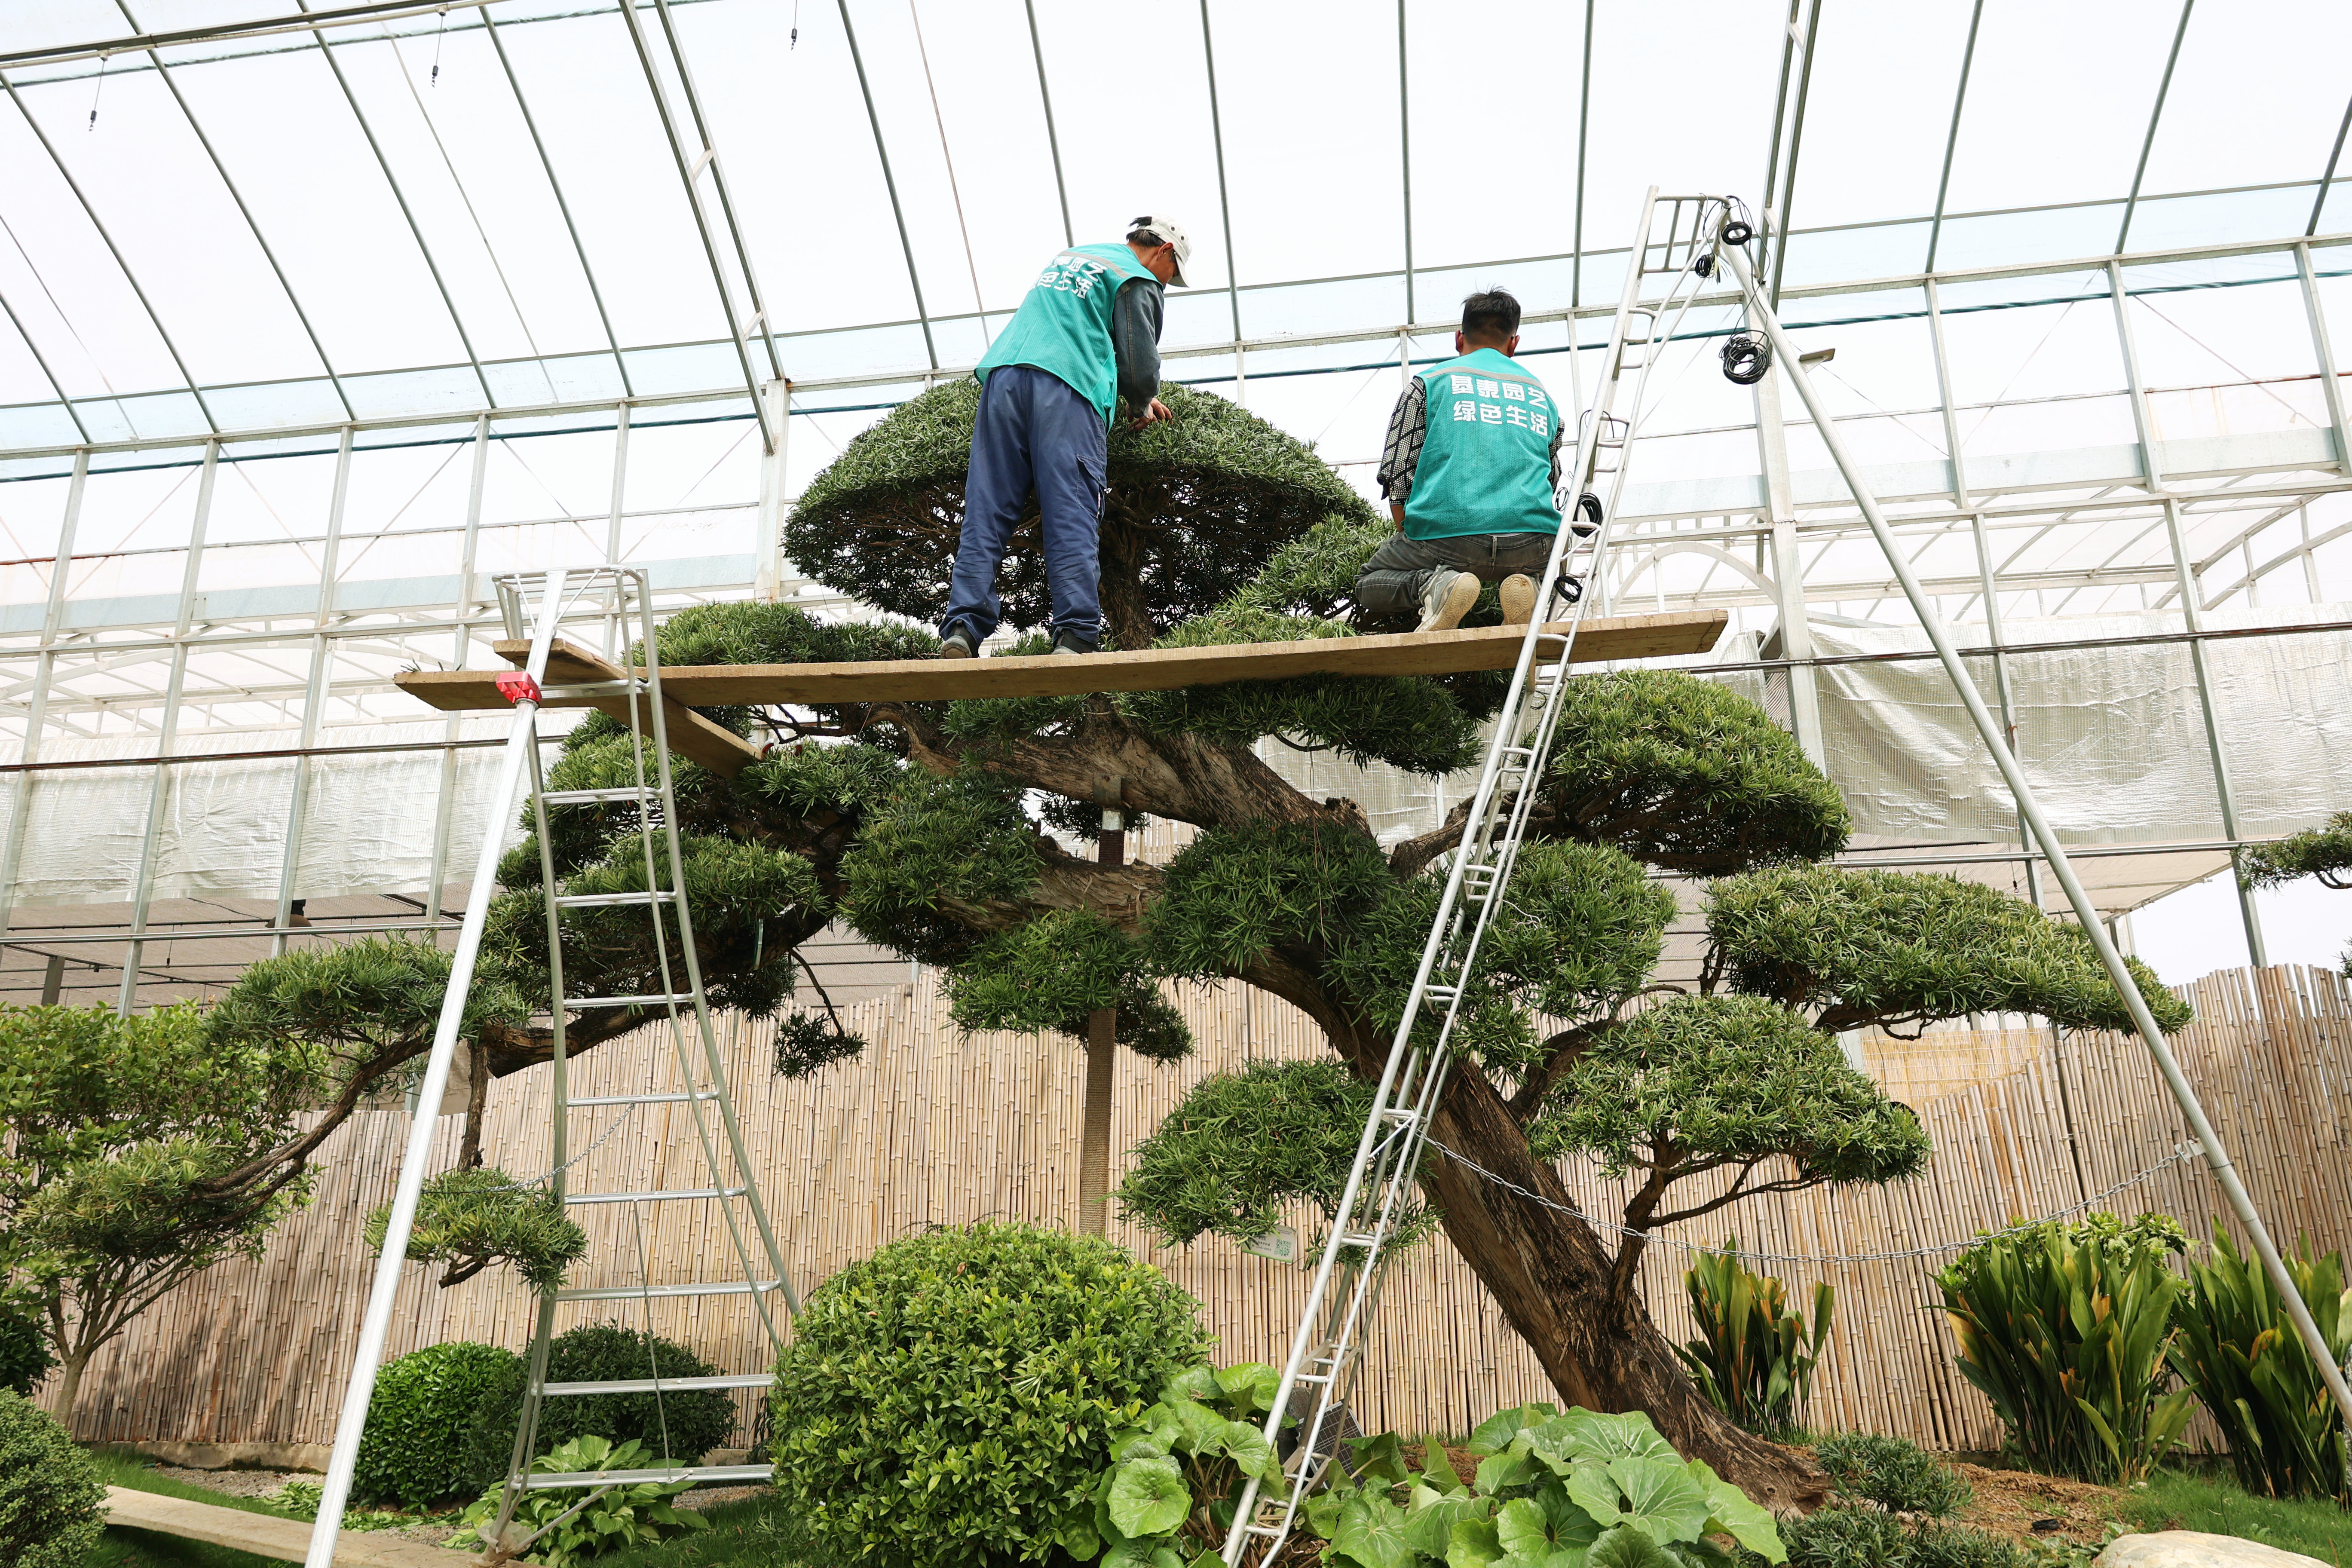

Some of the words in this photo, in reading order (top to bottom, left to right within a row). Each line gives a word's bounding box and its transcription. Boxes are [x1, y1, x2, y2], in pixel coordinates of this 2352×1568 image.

[1031, 271, 1093, 299] 色生活
[1451, 374, 1547, 409] 基泰园艺
[1453, 401, 1548, 436] 绿色生活
